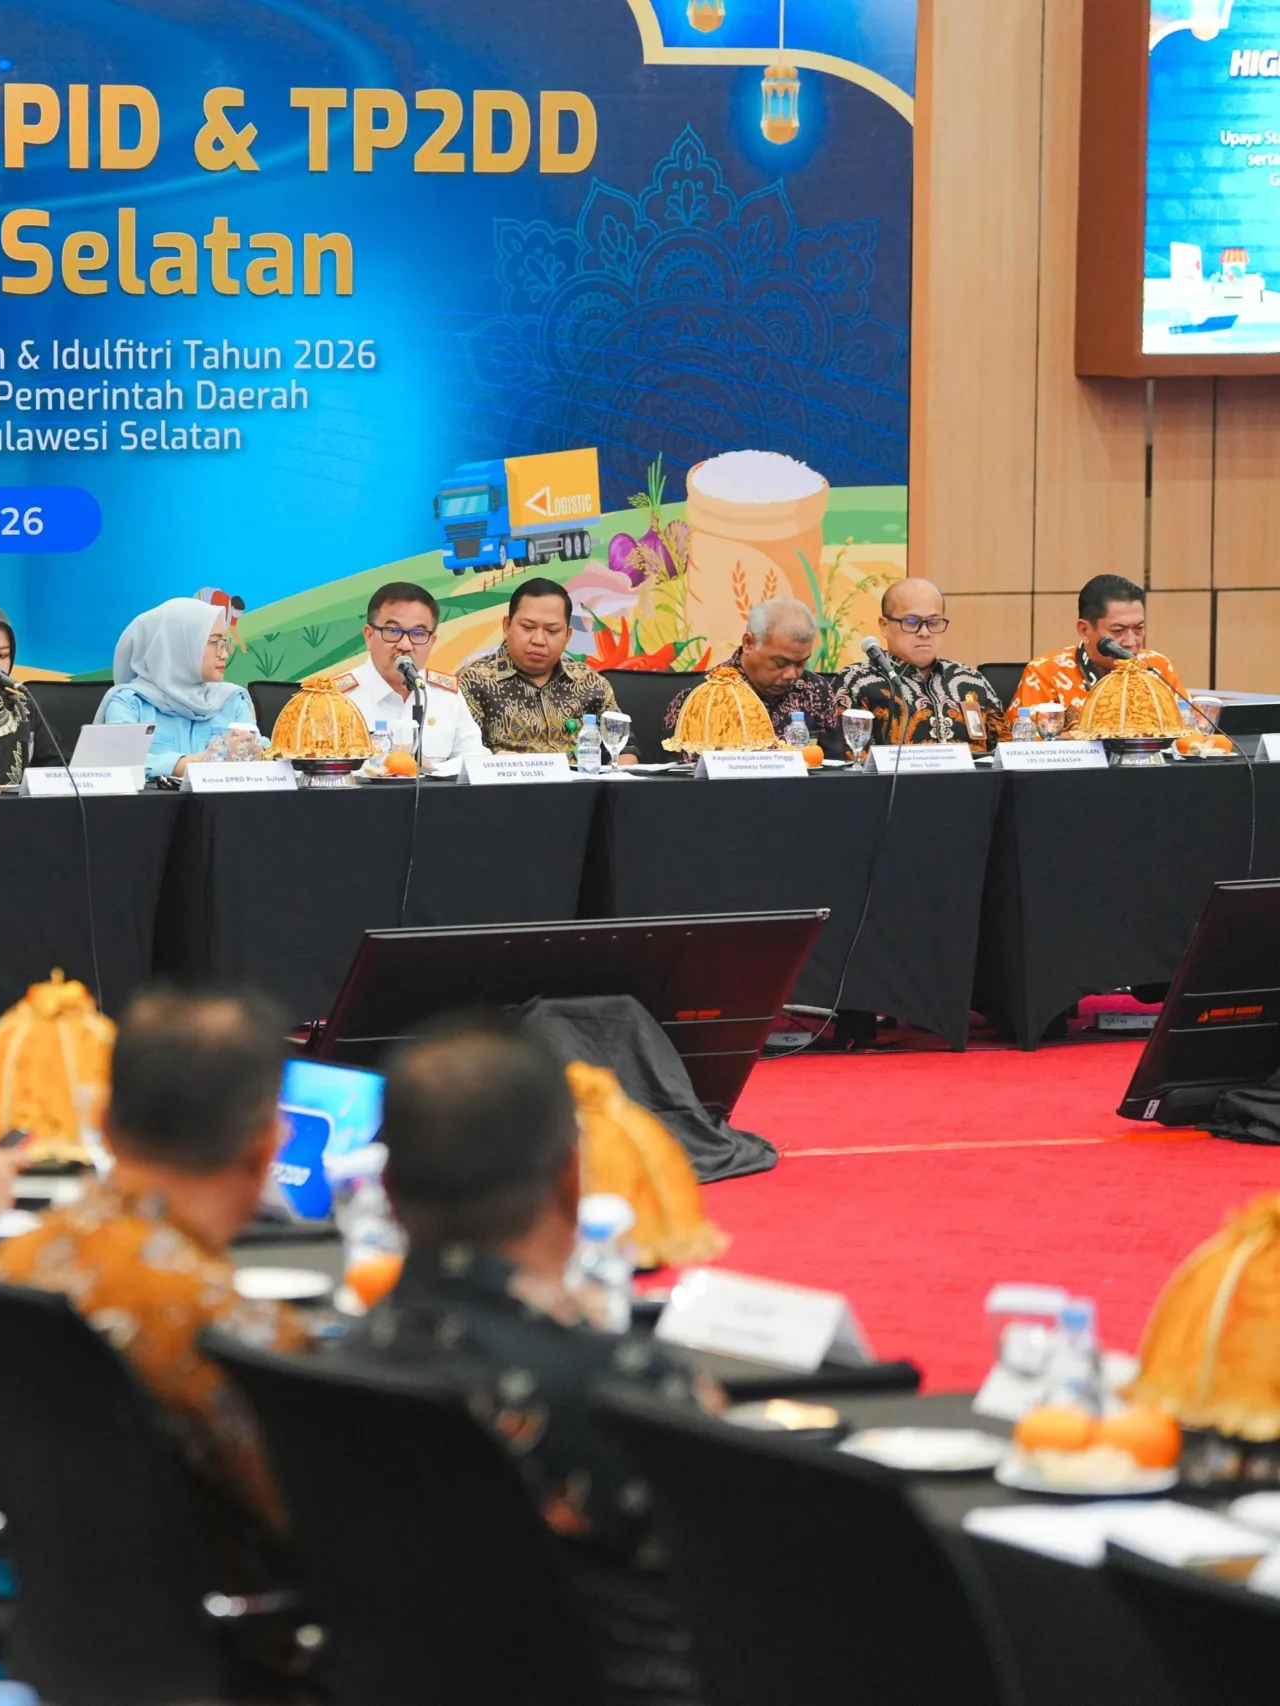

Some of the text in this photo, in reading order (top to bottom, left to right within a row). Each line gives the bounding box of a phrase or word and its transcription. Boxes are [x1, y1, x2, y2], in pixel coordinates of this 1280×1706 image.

[1229, 49, 1280, 77] HIG
[194, 87, 260, 172] &
[290, 87, 598, 174] TP2DD
[1220, 130, 1262, 148] Upaya
[0, 207, 354, 297] Selatan
[17, 340, 40, 370] &
[52, 339, 172, 370] Idulfitri
[184, 339, 282, 370] Tahun
[294, 340, 377, 370] 2026
[196, 379, 309, 410] Daerah
[120, 420, 242, 450] Selatan
[546, 486, 592, 517] LOGISTIC
